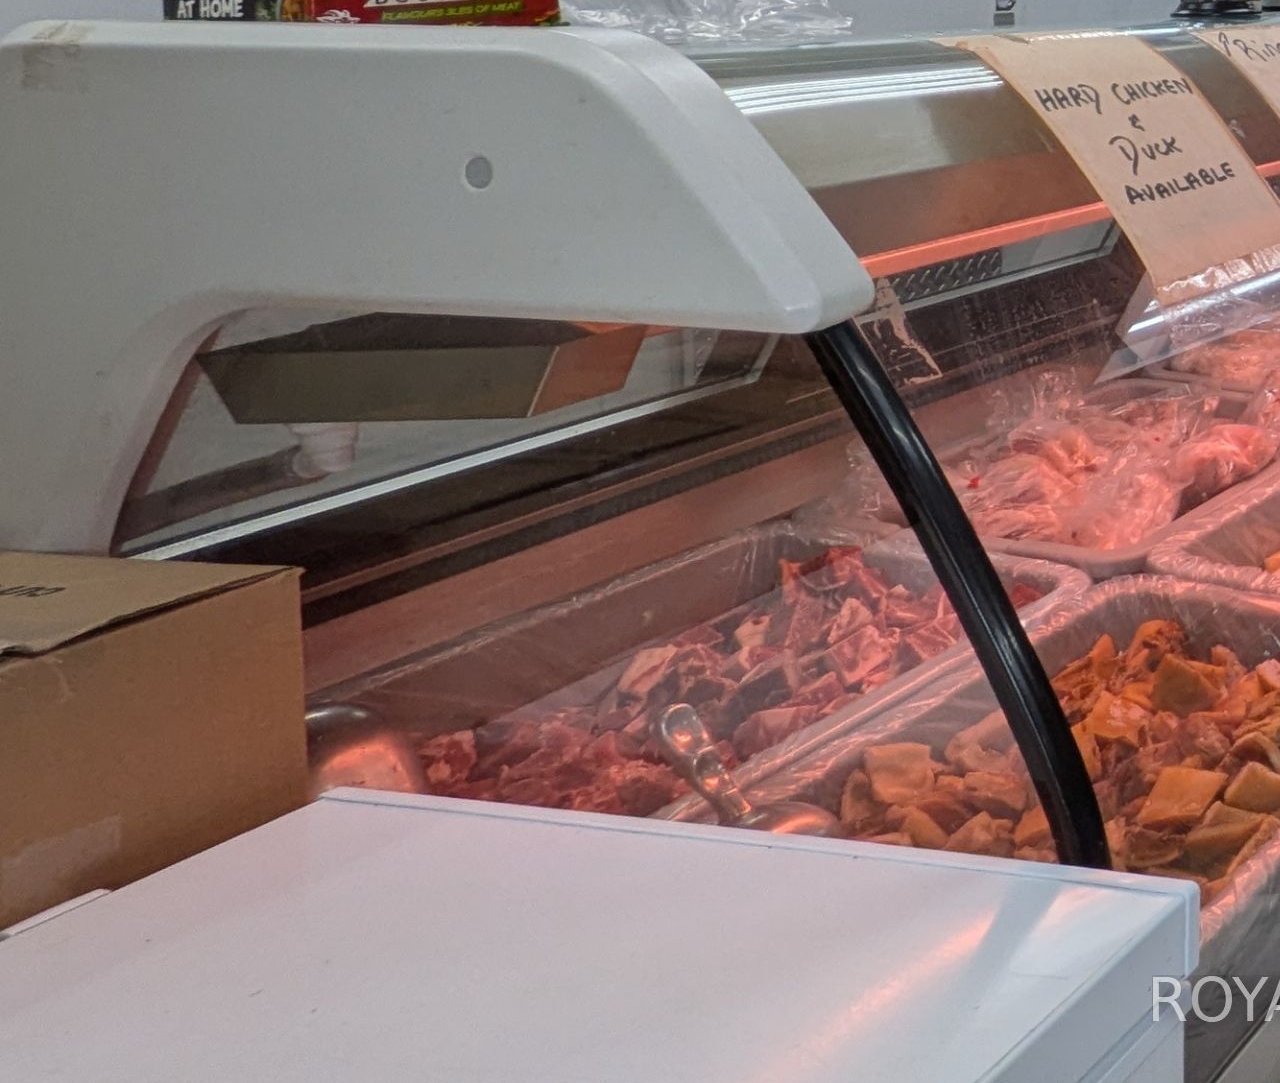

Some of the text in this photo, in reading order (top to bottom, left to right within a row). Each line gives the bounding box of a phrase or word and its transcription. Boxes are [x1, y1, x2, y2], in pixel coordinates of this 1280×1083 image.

[177, 0, 195, 19] AT
[1034, 77, 1194, 115] HARD CHICKEN
[1124, 161, 1237, 205] AVAILABLE
